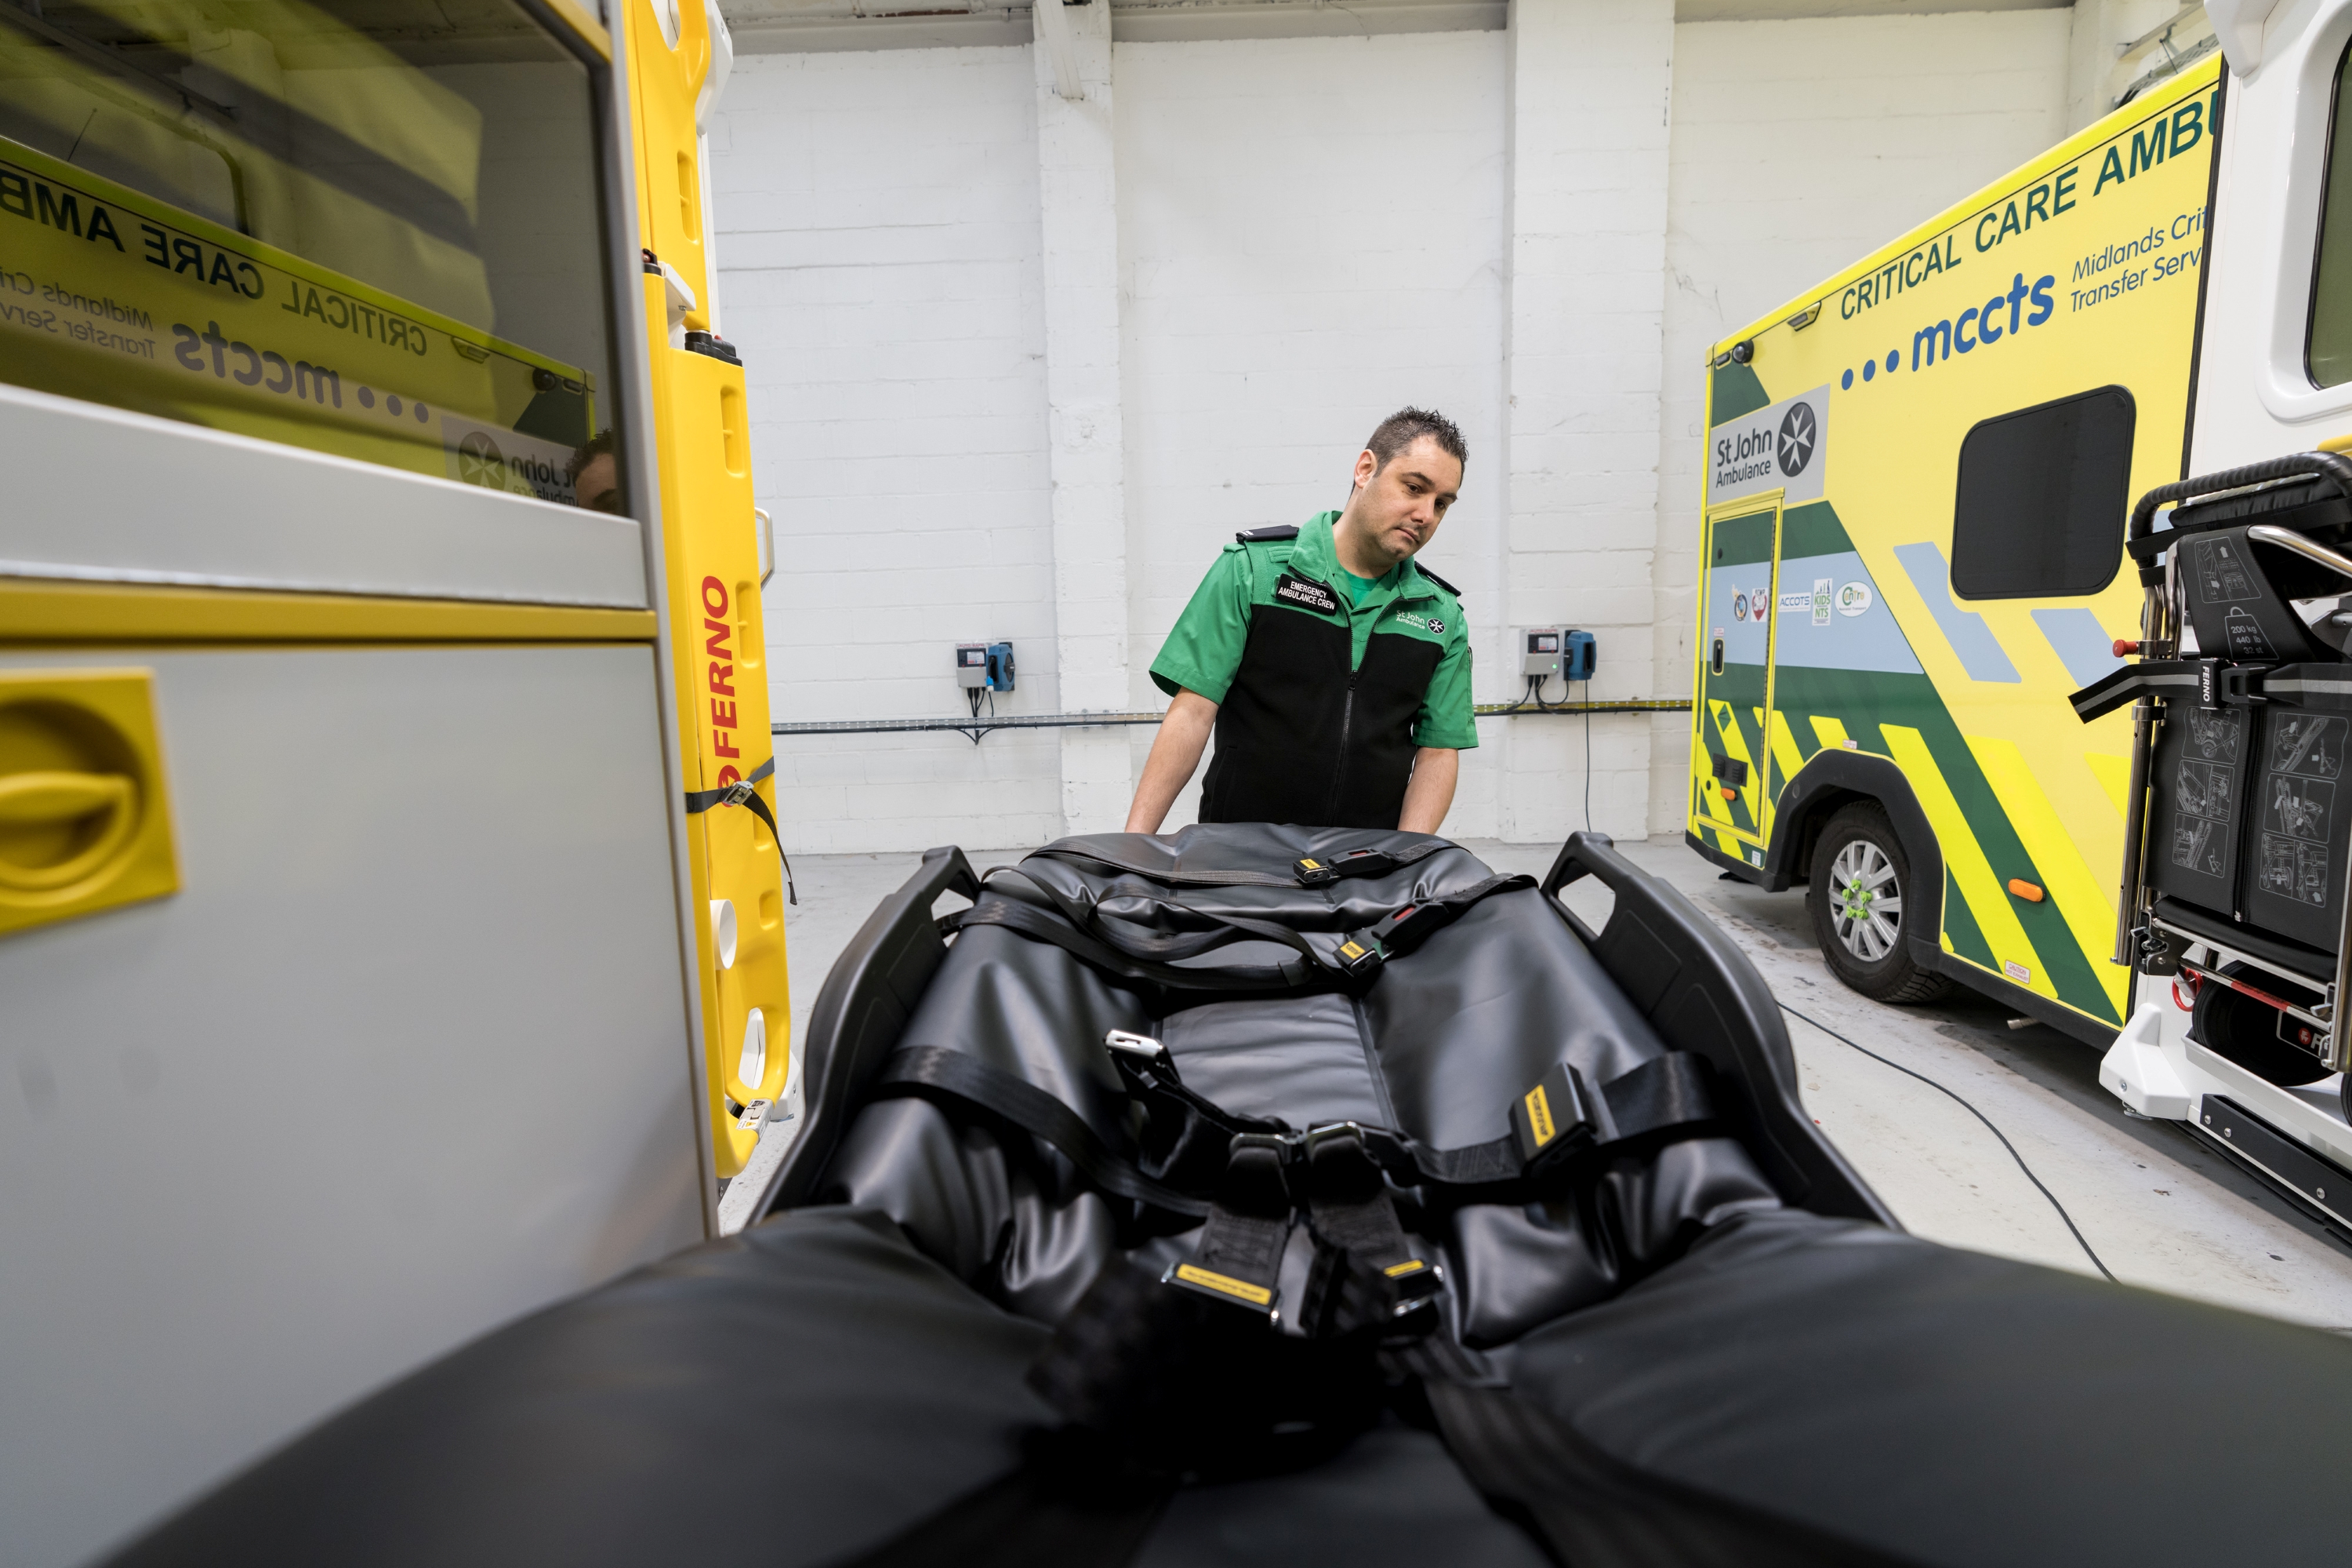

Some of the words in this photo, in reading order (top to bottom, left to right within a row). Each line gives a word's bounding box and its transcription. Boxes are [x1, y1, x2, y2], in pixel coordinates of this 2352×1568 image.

[1842, 234, 1962, 320] CRITICAL
[1975, 165, 2078, 252] CARE
[2092, 89, 2219, 197] AMB
[2072, 227, 2165, 283] Midlands
[2071, 268, 2148, 312] Transfer
[2153, 247, 2202, 281] Serv
[1911, 273, 2055, 372] mccts
[1717, 437, 1732, 467] St
[1733, 427, 1772, 463] John
[1715, 460, 1771, 488] Ambulance
[1278, 586, 1317, 605] AMBULANCE
[1317, 598, 1336, 610] CREW
[1290, 581, 1327, 599] EMERGENCY
[1779, 596, 1810, 607] ACCOTS
[1814, 594, 1831, 605] KIDS
[1396, 616, 1425, 630] Ambulance
[1406, 612, 1425, 624] John
[1815, 608, 1829, 618] NTS
[2246, 625, 2257, 633] kg
[702, 575, 740, 759] FERNO
